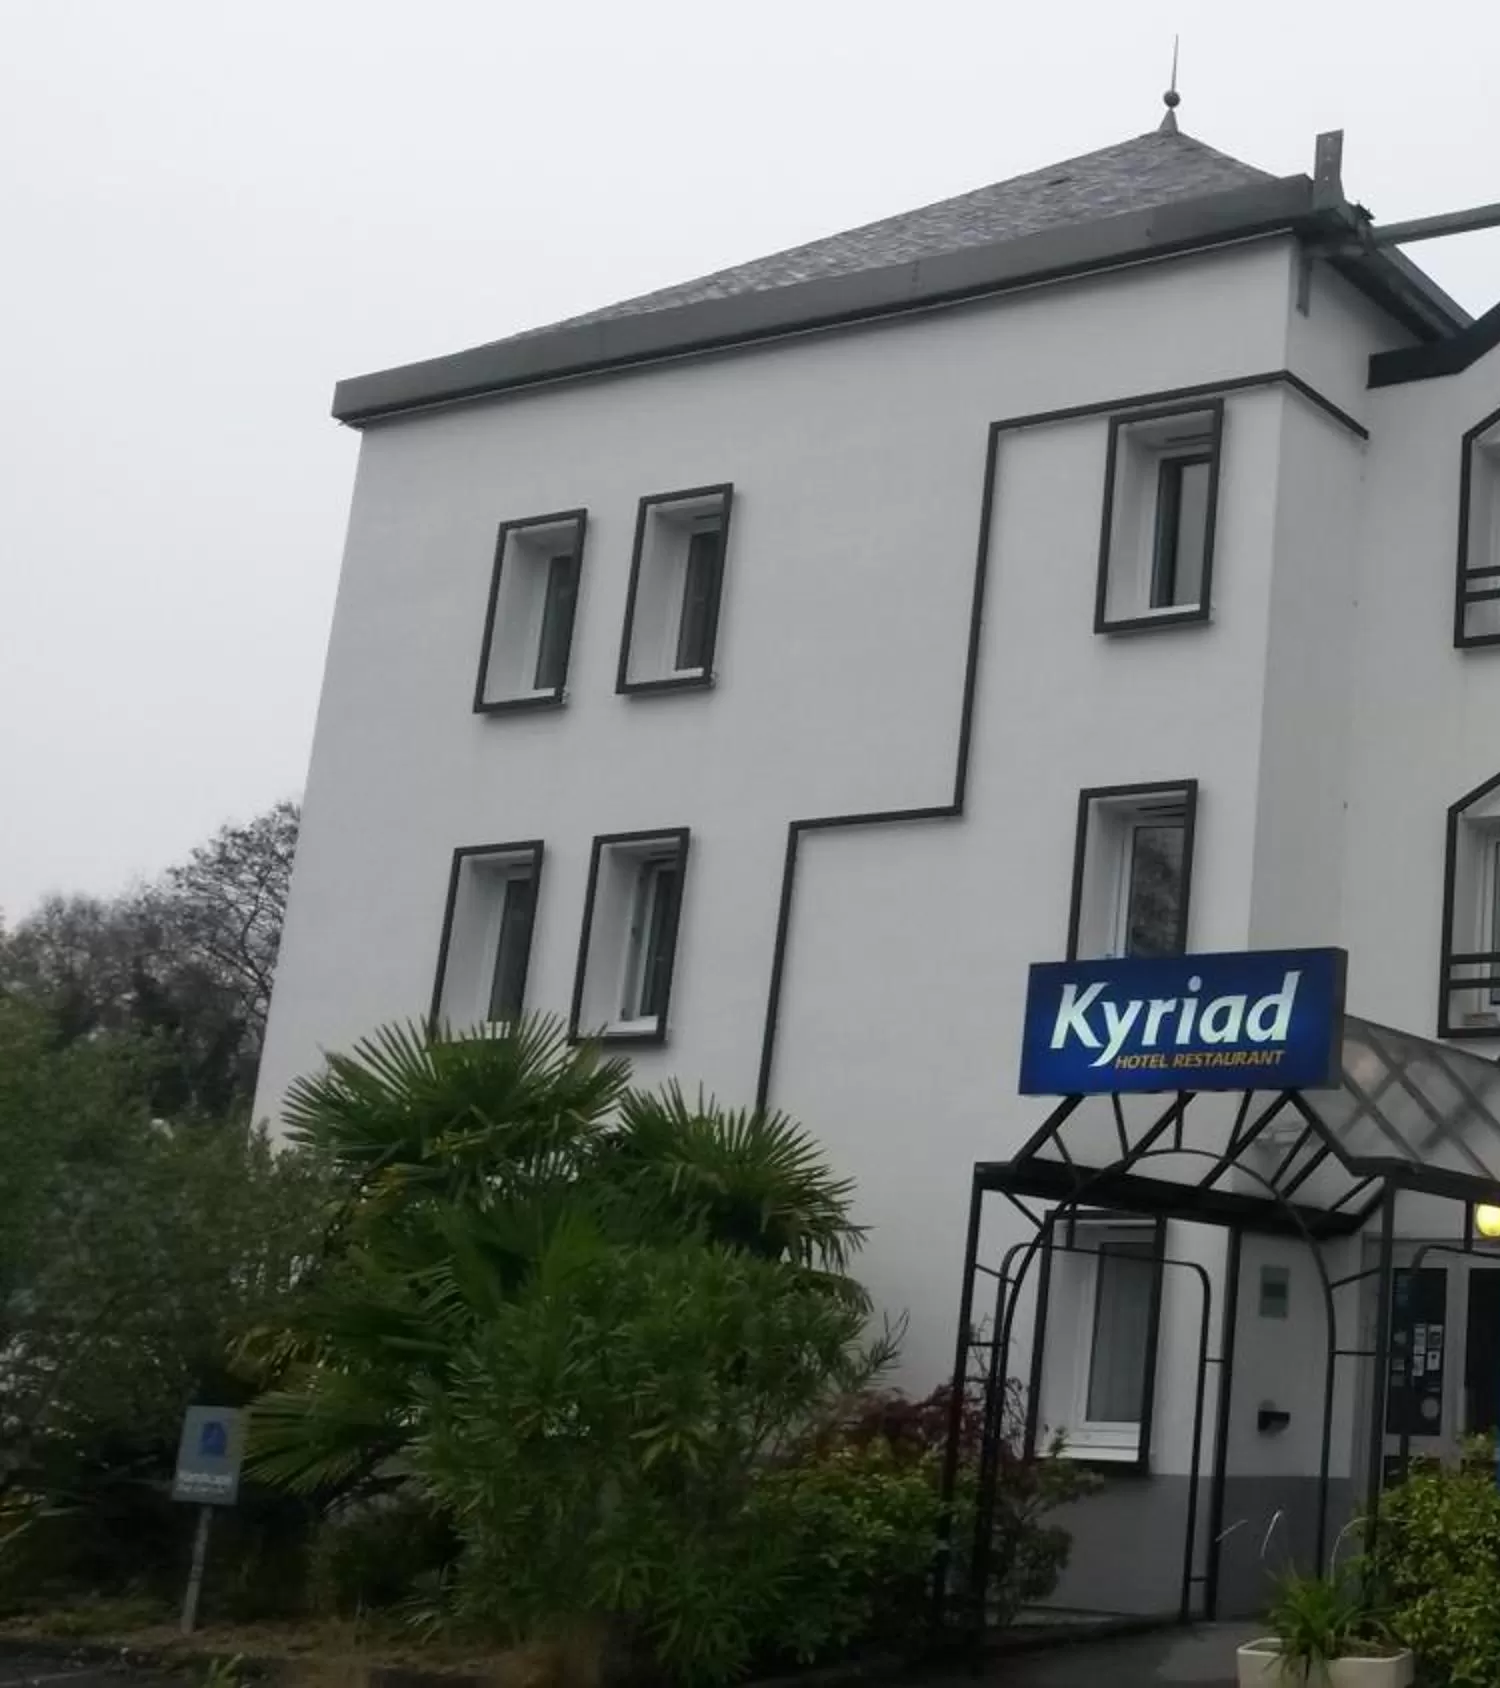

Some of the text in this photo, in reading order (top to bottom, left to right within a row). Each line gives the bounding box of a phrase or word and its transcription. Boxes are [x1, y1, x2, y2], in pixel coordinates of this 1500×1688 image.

[1050, 969, 1302, 1068] Kyriad
[1115, 1050, 1285, 1070] HOTEL RESTAURANT
